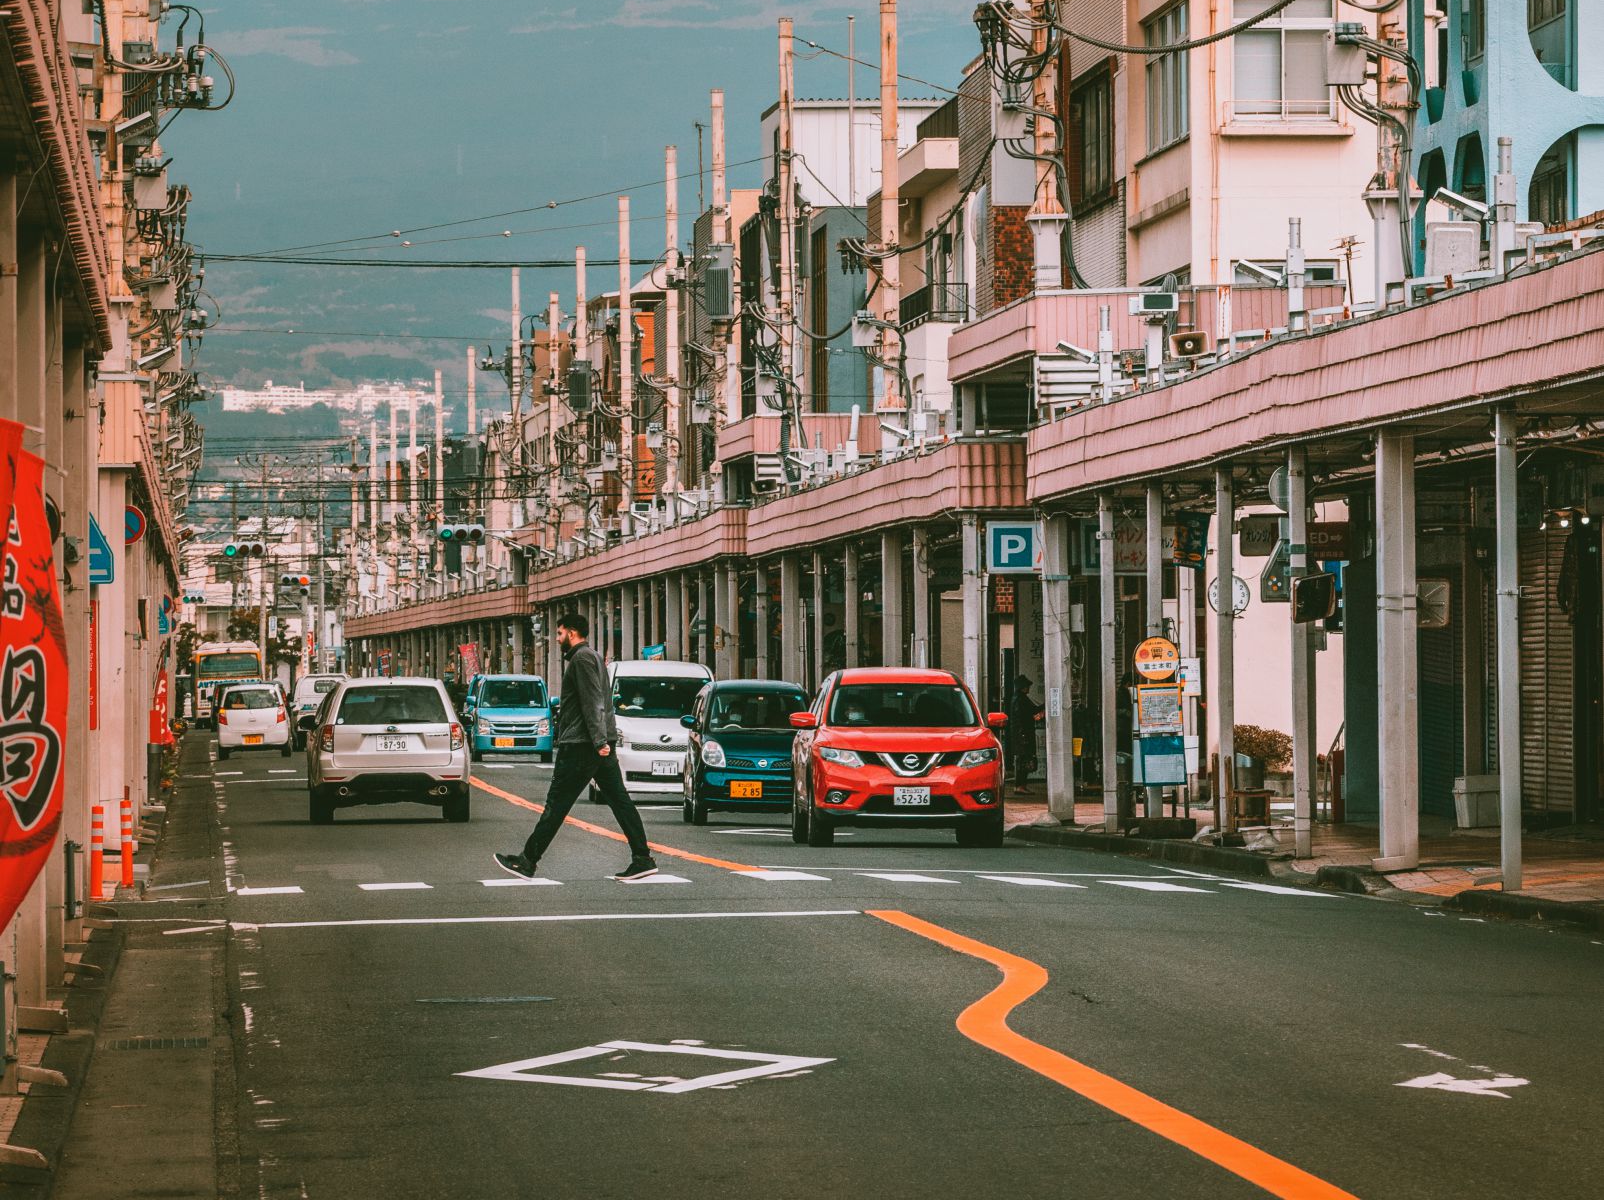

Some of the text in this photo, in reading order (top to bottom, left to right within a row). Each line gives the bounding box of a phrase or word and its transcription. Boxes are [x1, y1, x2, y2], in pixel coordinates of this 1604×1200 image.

[1117, 527, 1146, 544] オレン
[1309, 531, 1329, 544] ED
[1000, 534, 1026, 564] P
[901, 794, 928, 804] 52-36
